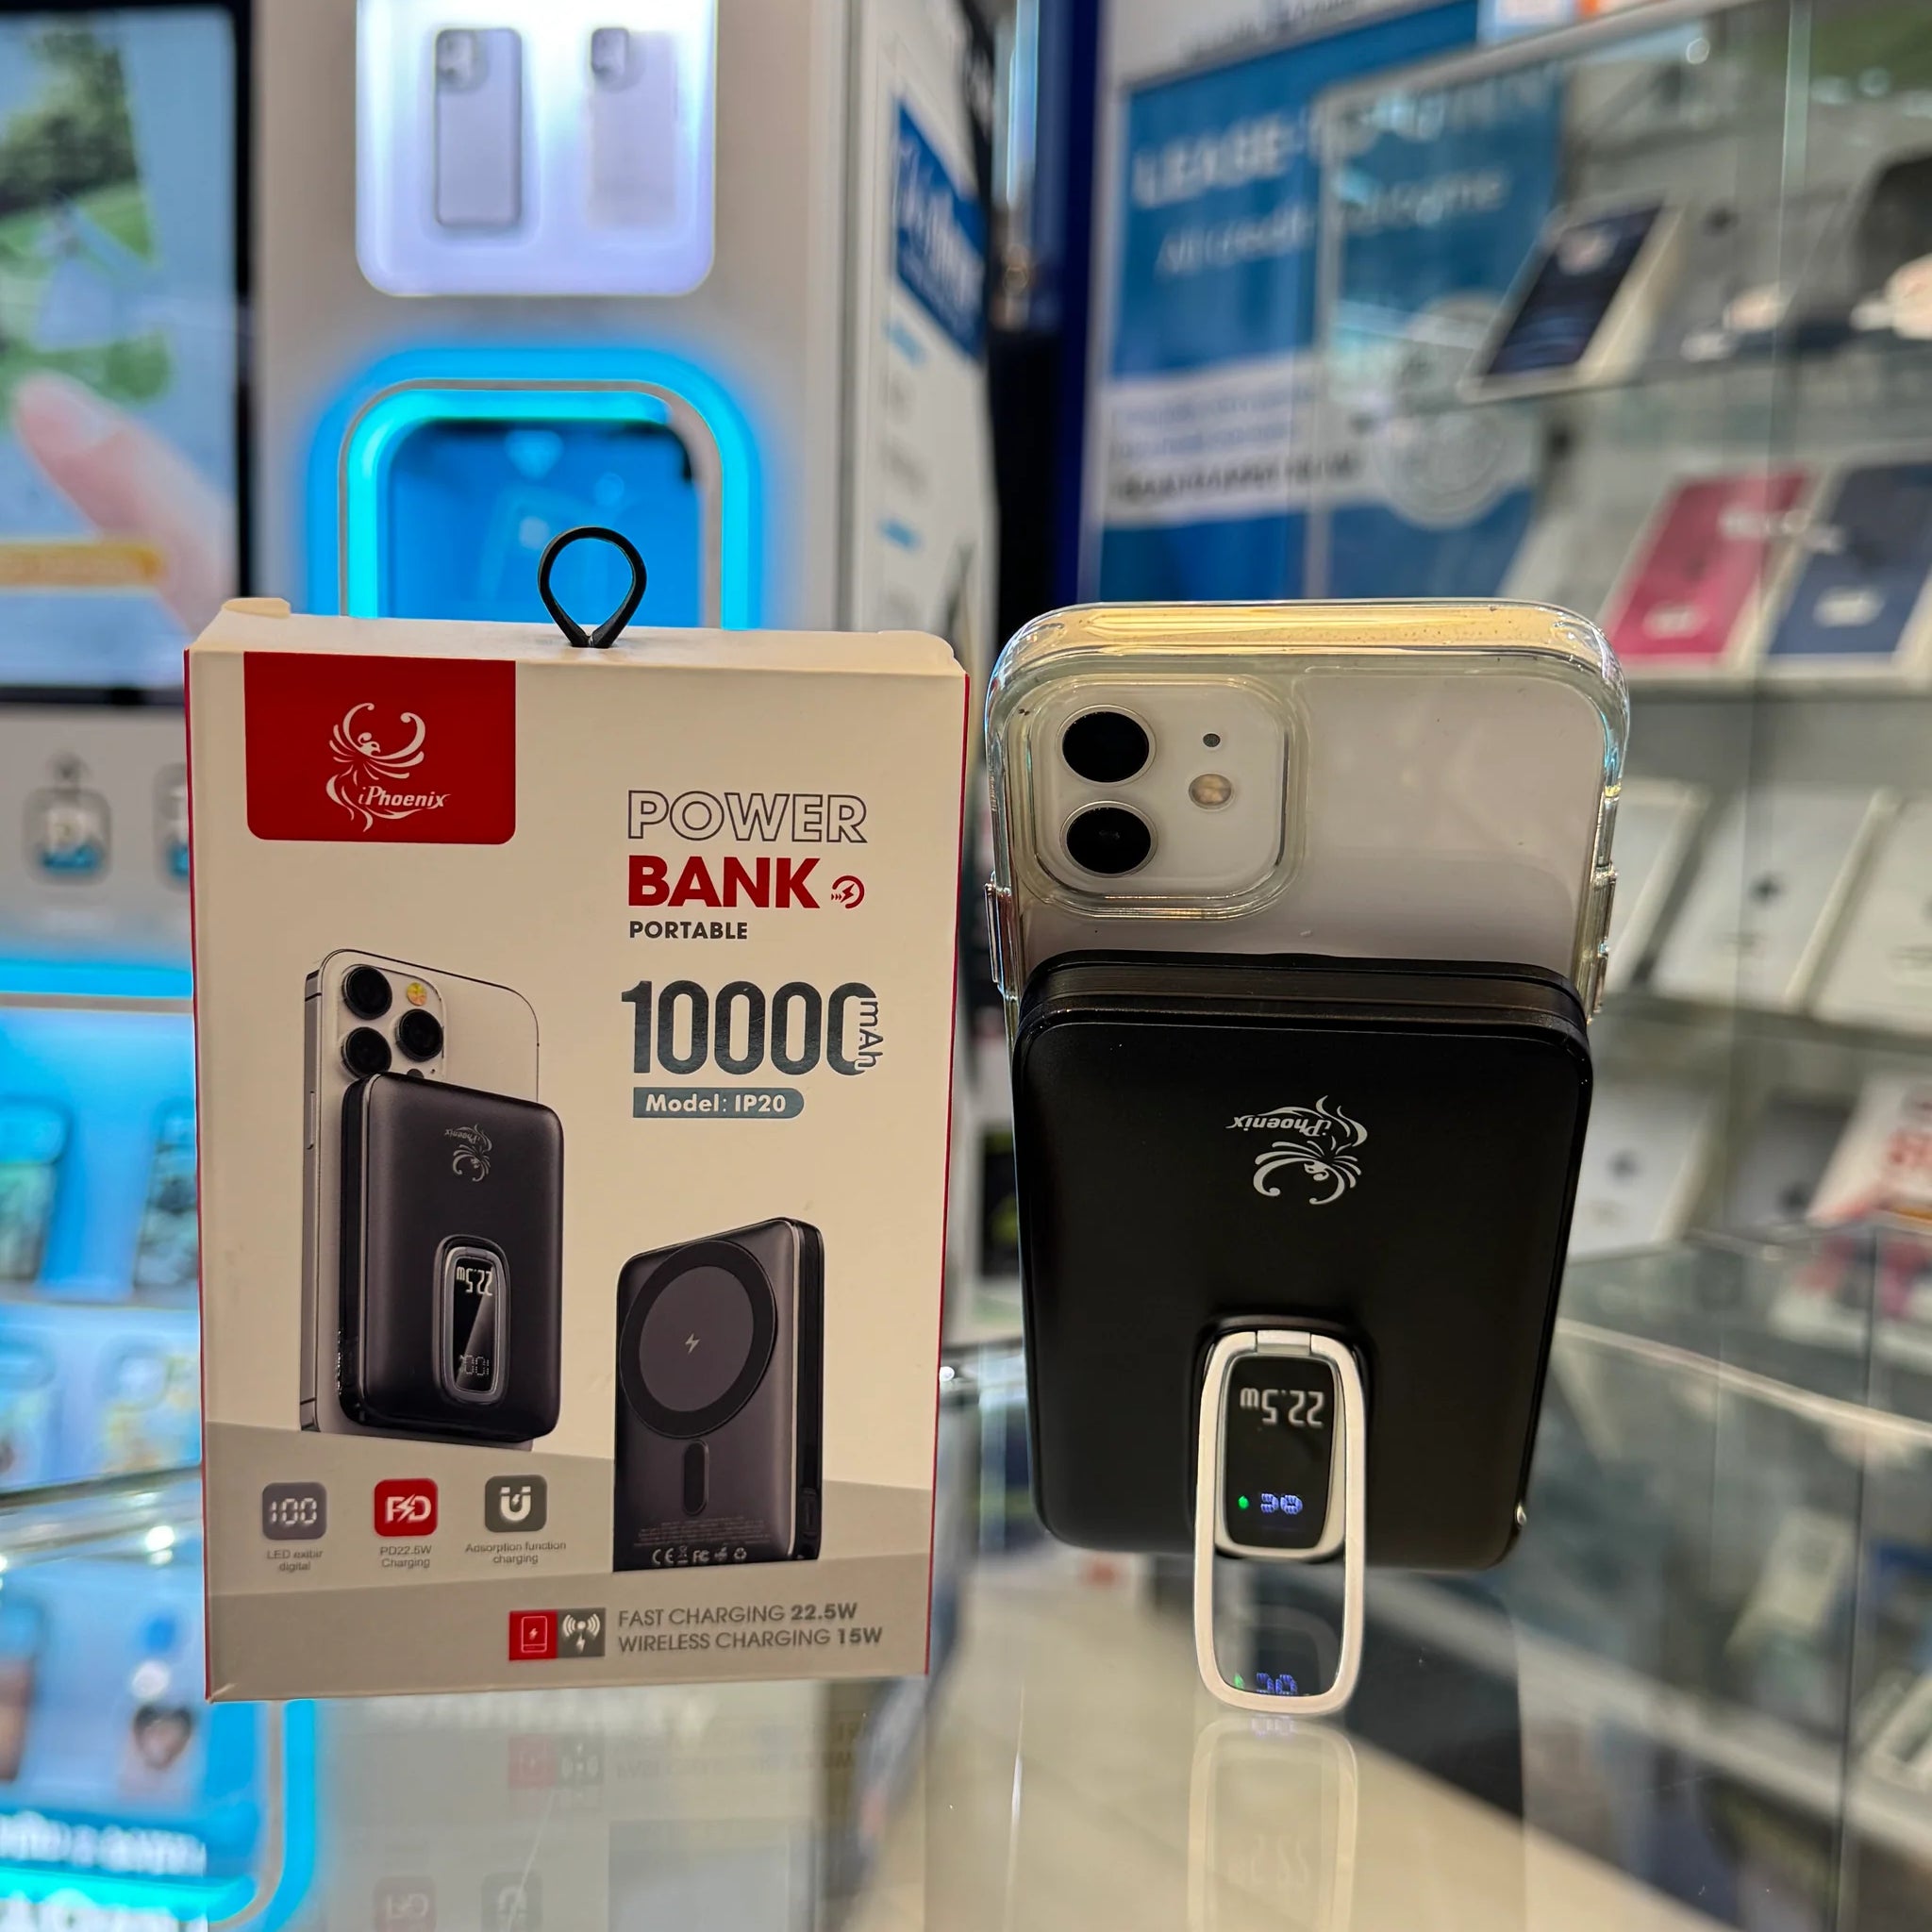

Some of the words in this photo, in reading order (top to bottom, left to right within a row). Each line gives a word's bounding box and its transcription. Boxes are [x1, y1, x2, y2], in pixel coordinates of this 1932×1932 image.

[358, 786, 451, 809] iPhoenix
[627, 790, 868, 843] POWER
[628, 855, 821, 908] BANK
[629, 921, 748, 940] PORTABLE
[858, 1000, 884, 1069] mAh
[645, 1093, 728, 1113] Model:
[734, 1093, 787, 1113] IP20
[1225, 1116, 1332, 1137] iPhoenix
[271, 1497, 317, 1525] 100
[380, 1545, 432, 1557] PD22.5W
[525, 1541, 566, 1552] function
[278, 1561, 311, 1574] digital
[381, 1557, 431, 1569] Charging
[492, 1554, 539, 1566] charging
[618, 1609, 663, 1627] FAST
[669, 1606, 785, 1626] CHARGING
[791, 1603, 858, 1621] 22.5W
[619, 1635, 710, 1653] WIRELESS
[715, 1629, 830, 1650] CHARGING
[837, 1626, 884, 1644] 15W
